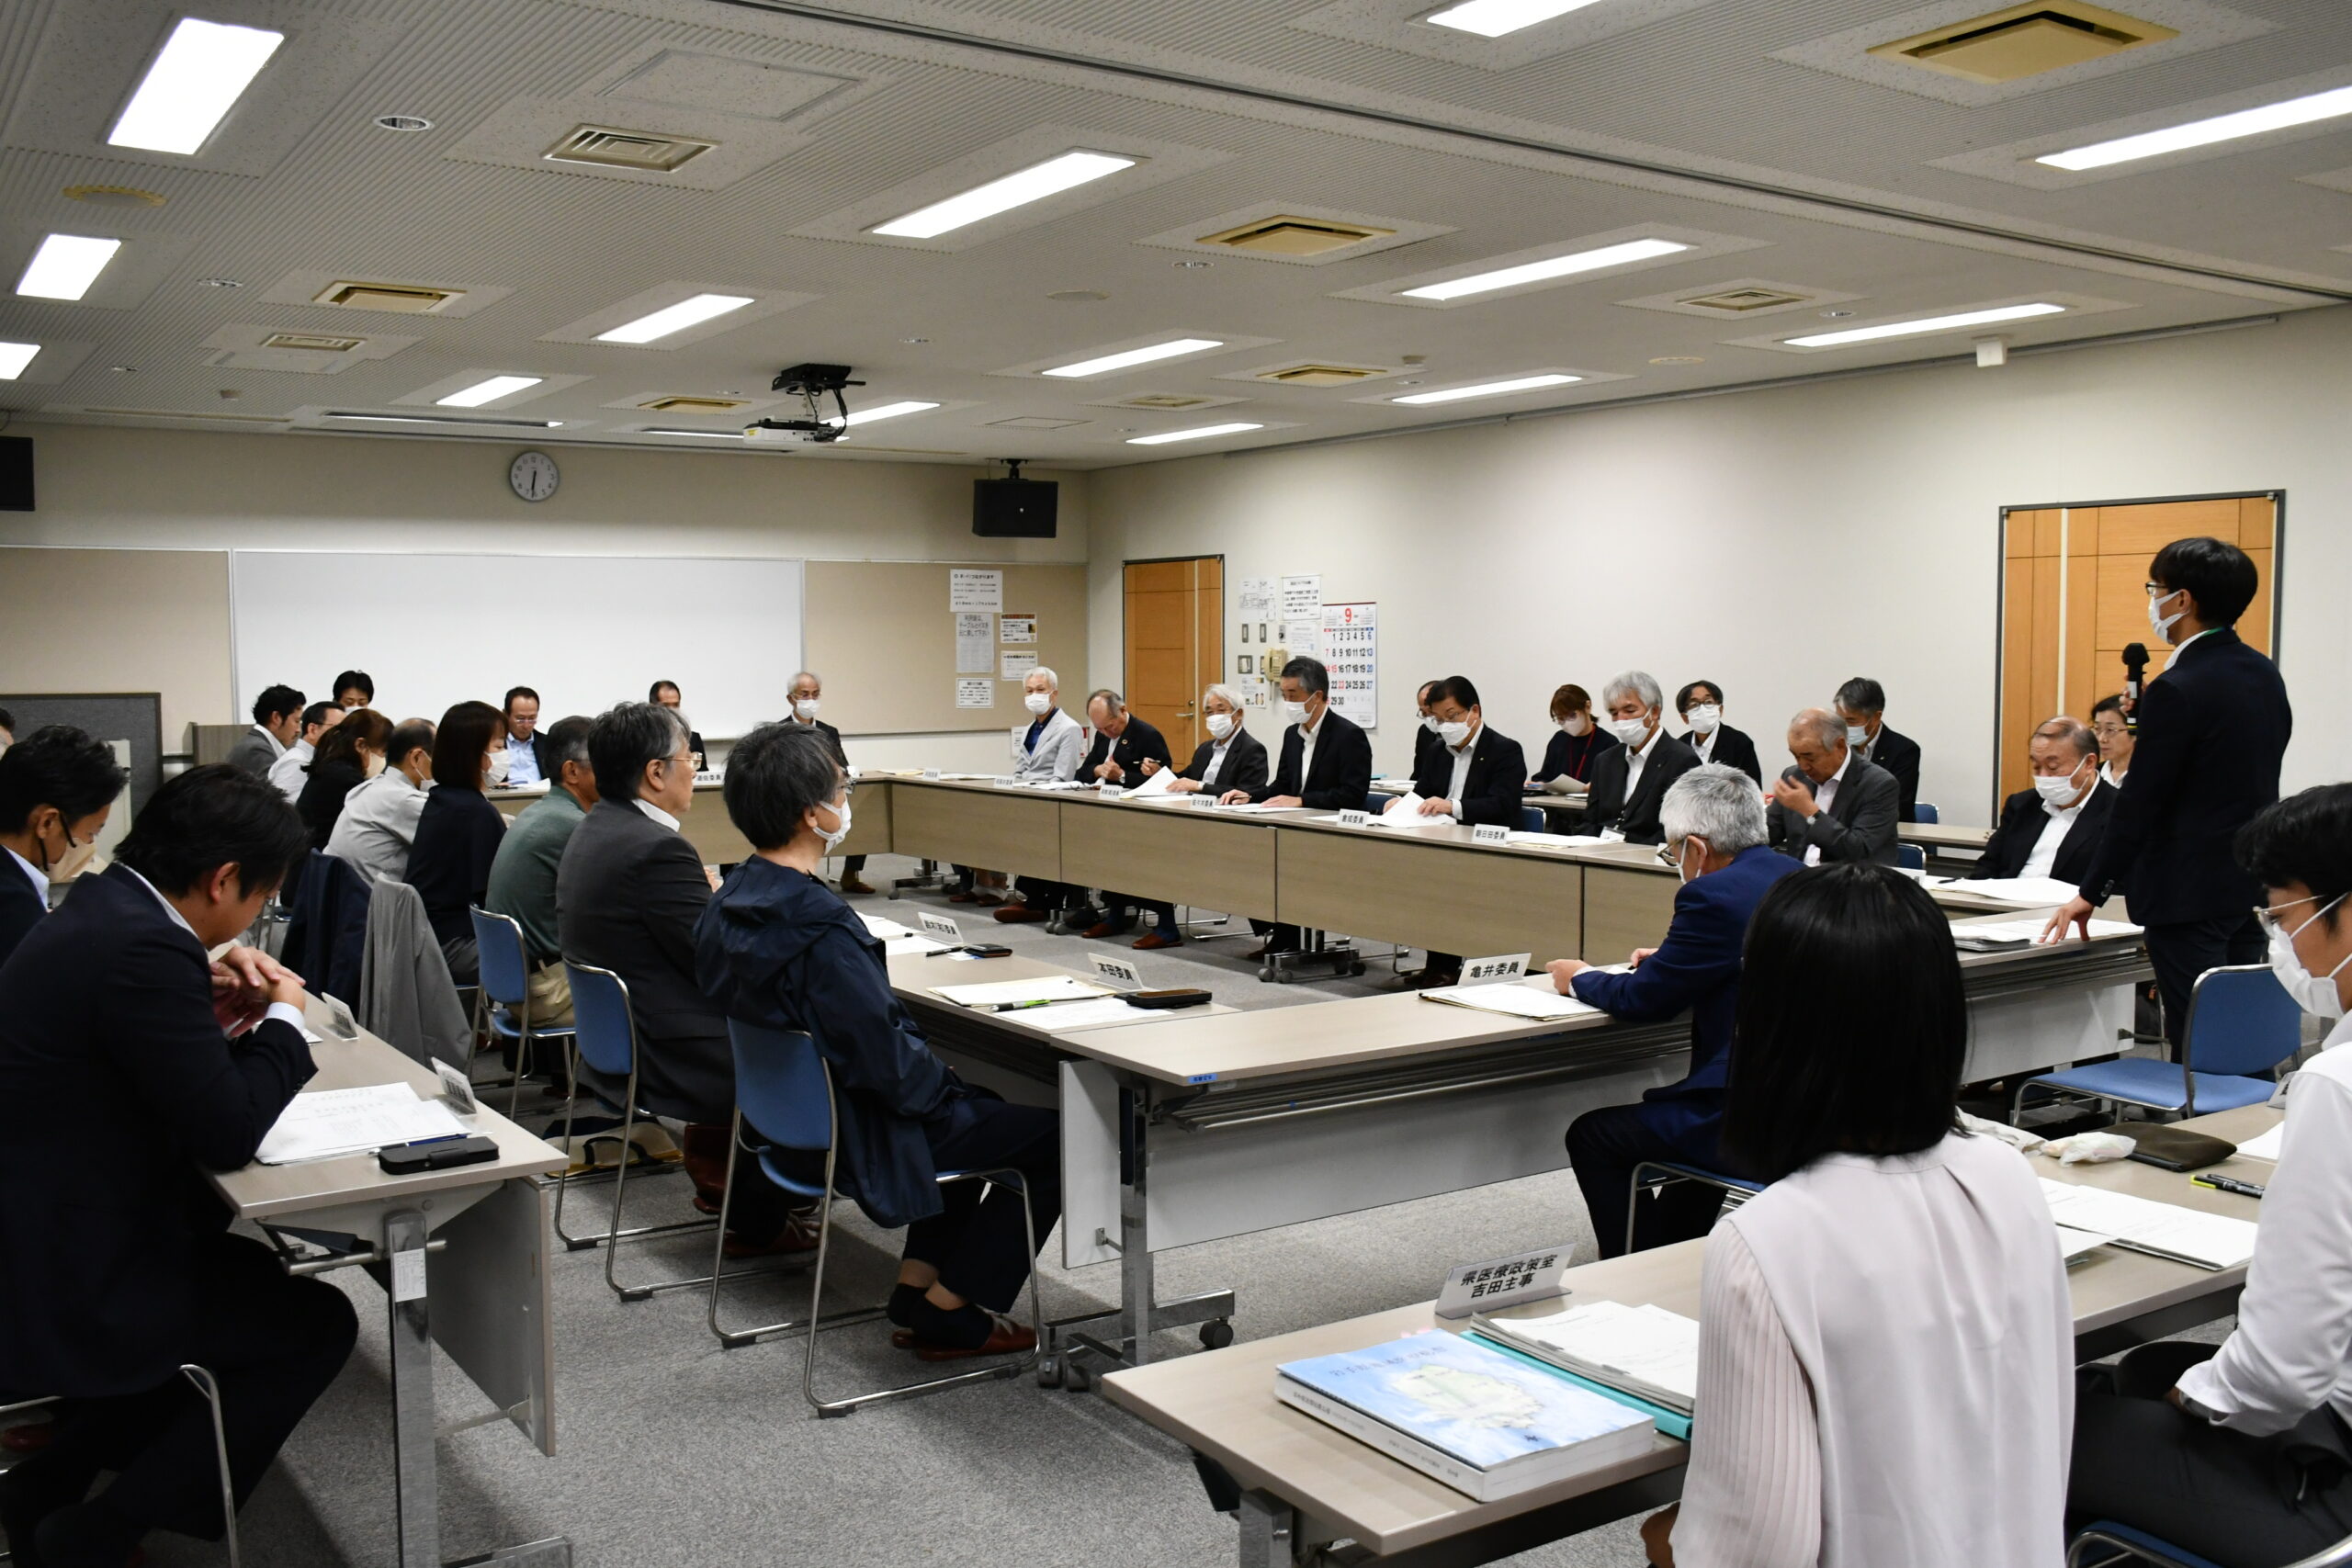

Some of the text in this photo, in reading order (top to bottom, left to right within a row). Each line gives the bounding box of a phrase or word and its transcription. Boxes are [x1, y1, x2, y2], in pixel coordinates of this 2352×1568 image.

[1345, 607, 1352, 623] 9
[1345, 648, 1351, 657] 10
[1352, 648, 1359, 657] 11
[1360, 648, 1366, 657] 12
[1366, 648, 1374, 657] 13
[1331, 664, 1338, 673] 15
[1338, 664, 1344, 673] 16
[1345, 664, 1351, 673] 17
[1352, 664, 1359, 673] 18
[1360, 664, 1366, 673] 19
[1331, 681, 1338, 689] 22
[1345, 681, 1351, 689] 24
[1352, 681, 1359, 689] 25
[1359, 681, 1366, 689] 26
[1331, 696, 1338, 705] 29
[1338, 696, 1344, 705] 30
[1470, 961, 1520, 978] 亀井委員
[1460, 1254, 1558, 1287] 県医療政策室
[1470, 1272, 1535, 1299] 吉田主事
